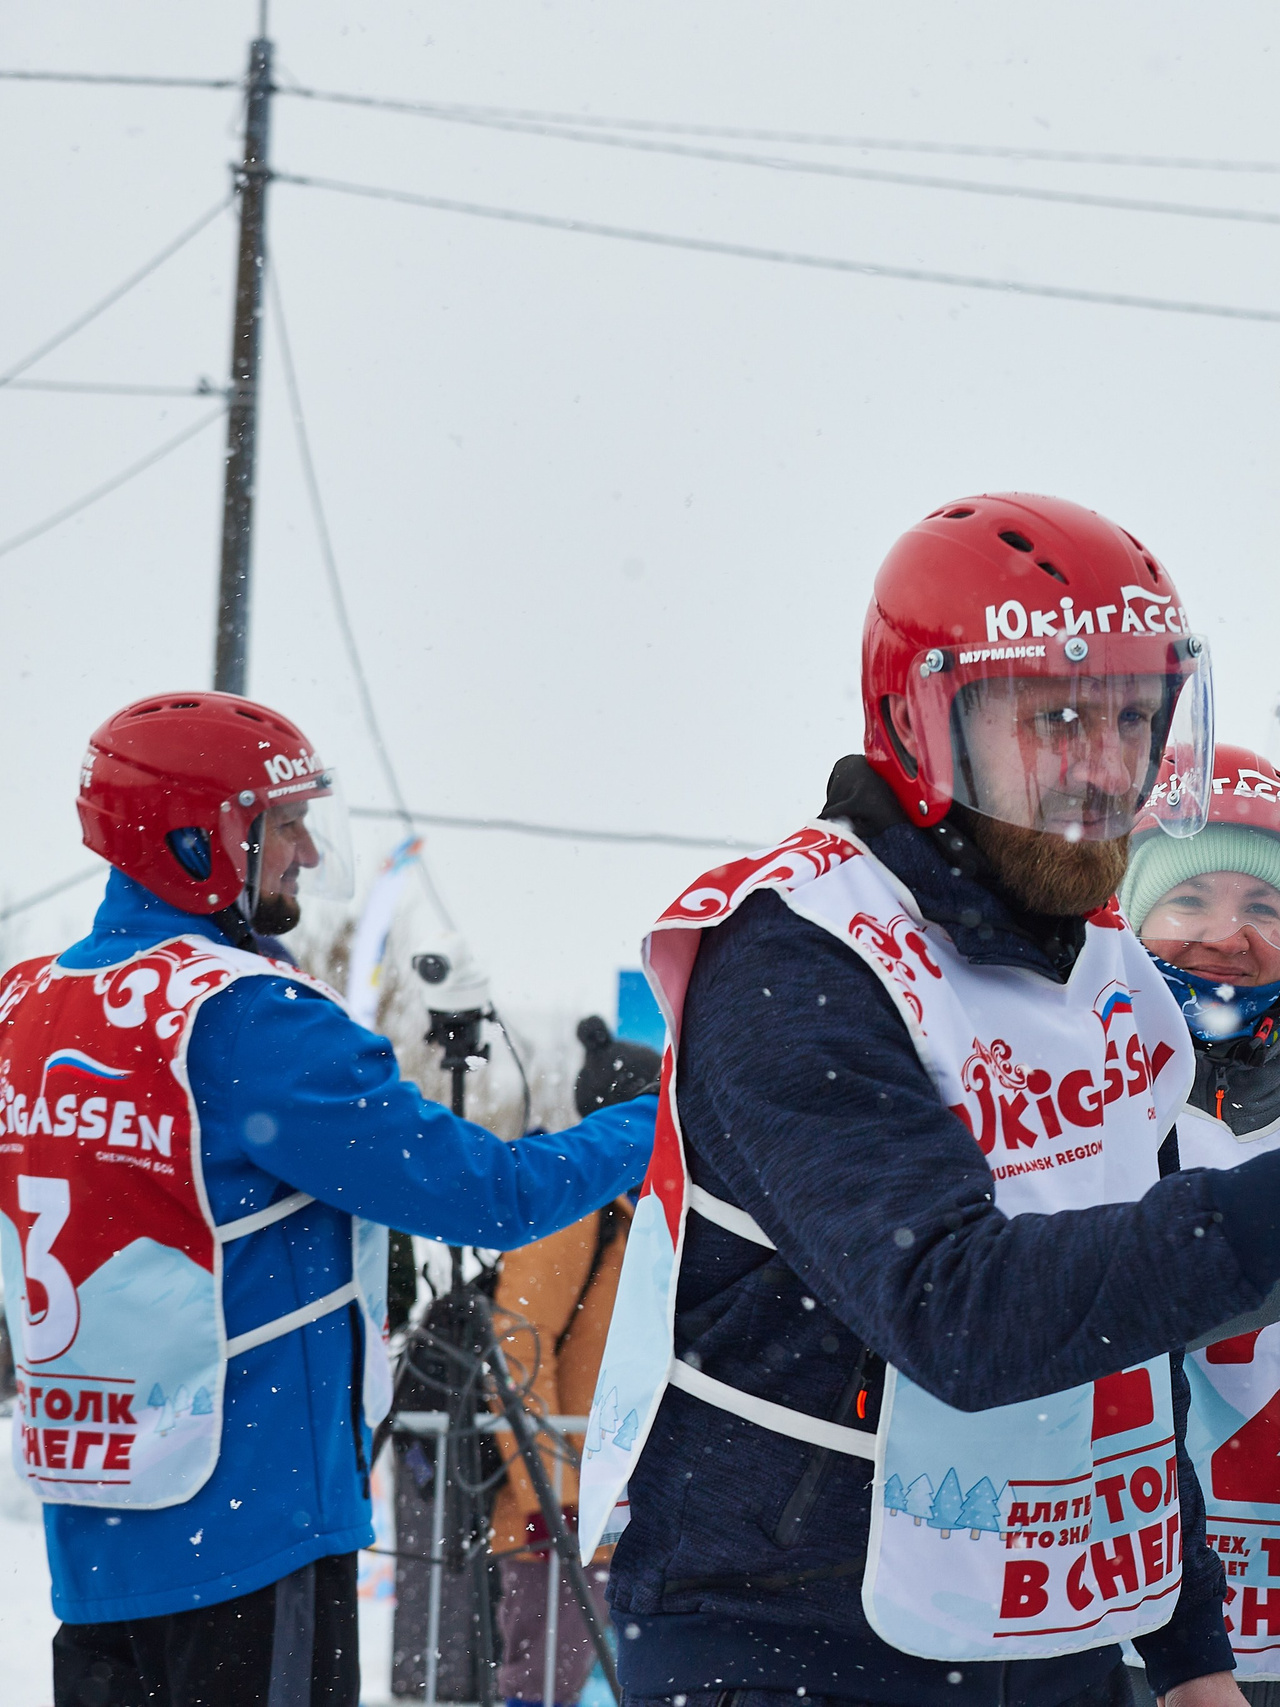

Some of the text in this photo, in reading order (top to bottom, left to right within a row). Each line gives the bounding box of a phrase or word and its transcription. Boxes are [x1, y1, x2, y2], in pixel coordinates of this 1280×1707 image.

[960, 646, 1045, 664] МУРМАНСК
[1055, 1138, 1103, 1165] REGION
[17, 1174, 80, 1364] 3
[1007, 1500, 1068, 1527] ДЛЯ
[1006, 1530, 1055, 1549] КТО
[1000, 1512, 1183, 1619] В СНЕГ
